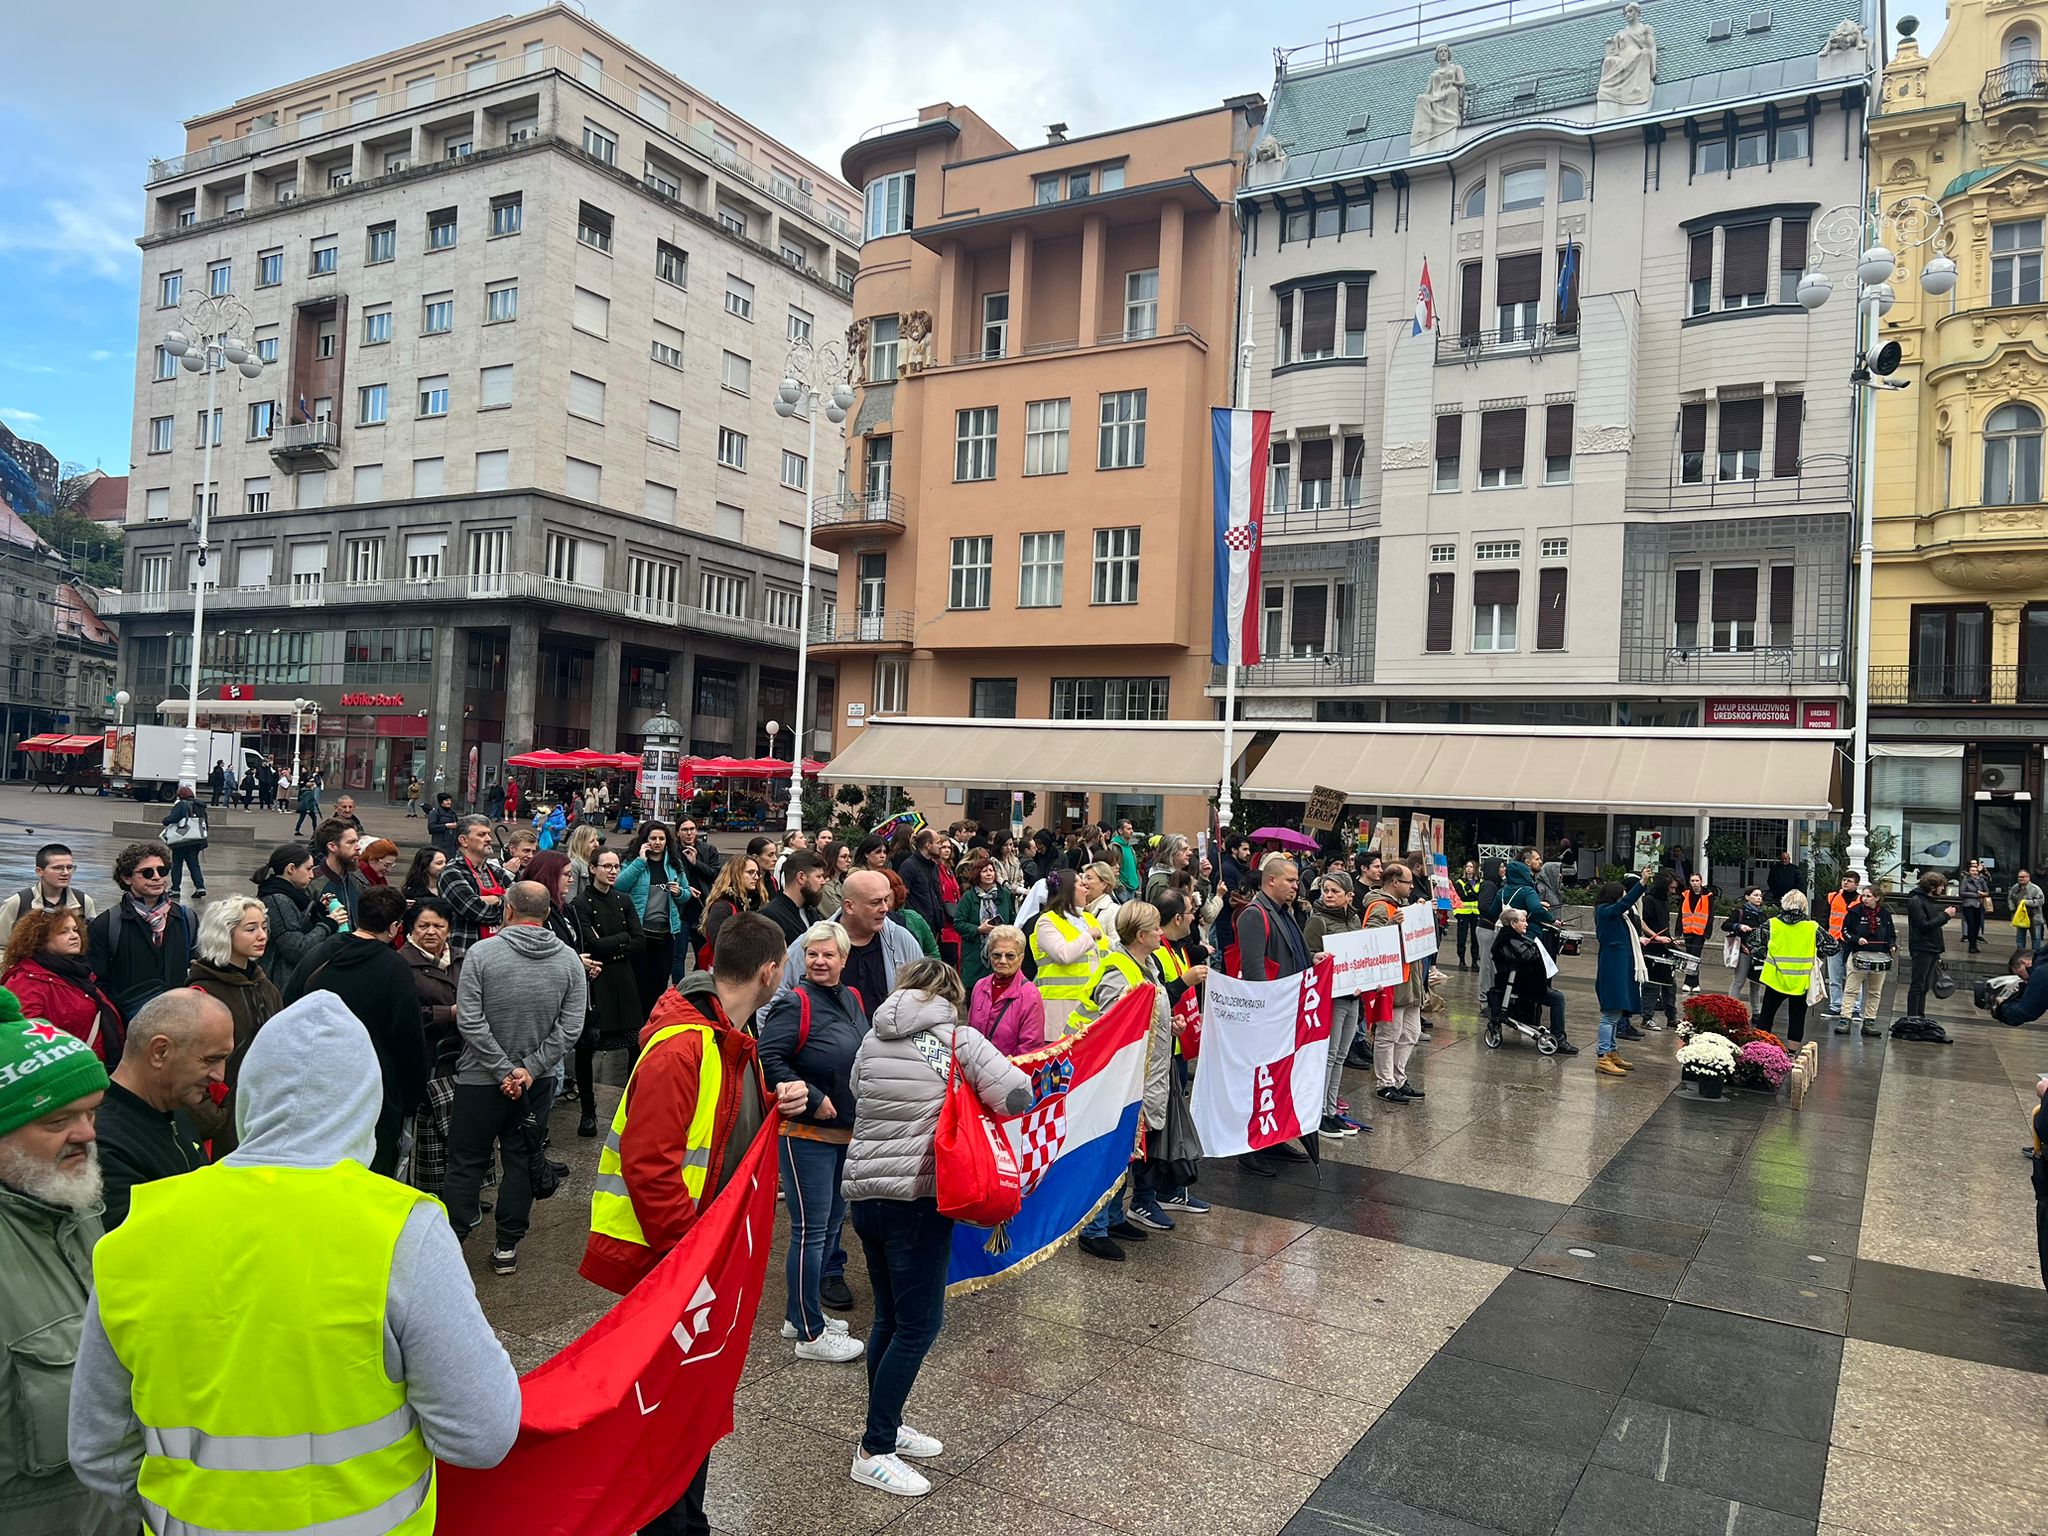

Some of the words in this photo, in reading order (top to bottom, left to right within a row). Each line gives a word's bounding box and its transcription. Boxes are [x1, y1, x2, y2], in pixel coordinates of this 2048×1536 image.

[1713, 703, 1736, 712] ZAKUP
[1737, 703, 1790, 712] EKSKLUZIVNOG
[1713, 711, 1751, 720] UREDSKOG
[1752, 712, 1790, 720] PROSTORA
[1953, 720, 2035, 735] Galerija
[0, 1039, 87, 1088] Heine
[1258, 1063, 1278, 1136] SDP
